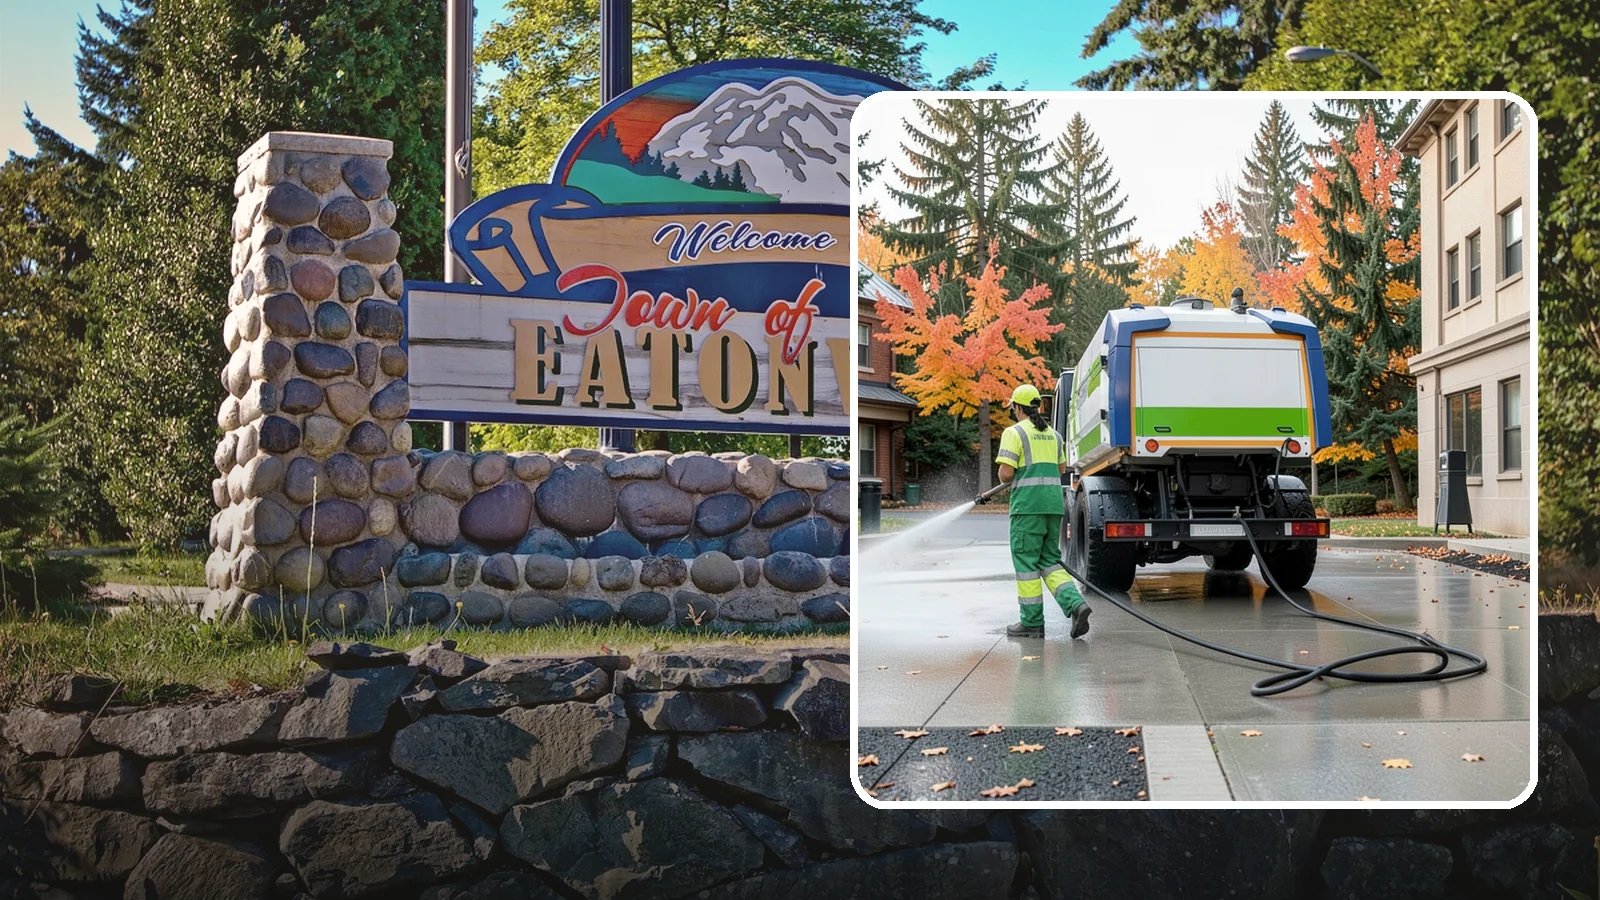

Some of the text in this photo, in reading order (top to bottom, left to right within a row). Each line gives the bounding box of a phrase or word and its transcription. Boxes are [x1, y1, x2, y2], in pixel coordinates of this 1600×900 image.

[654, 221, 837, 263] Welcome
[557, 264, 826, 365] Town of
